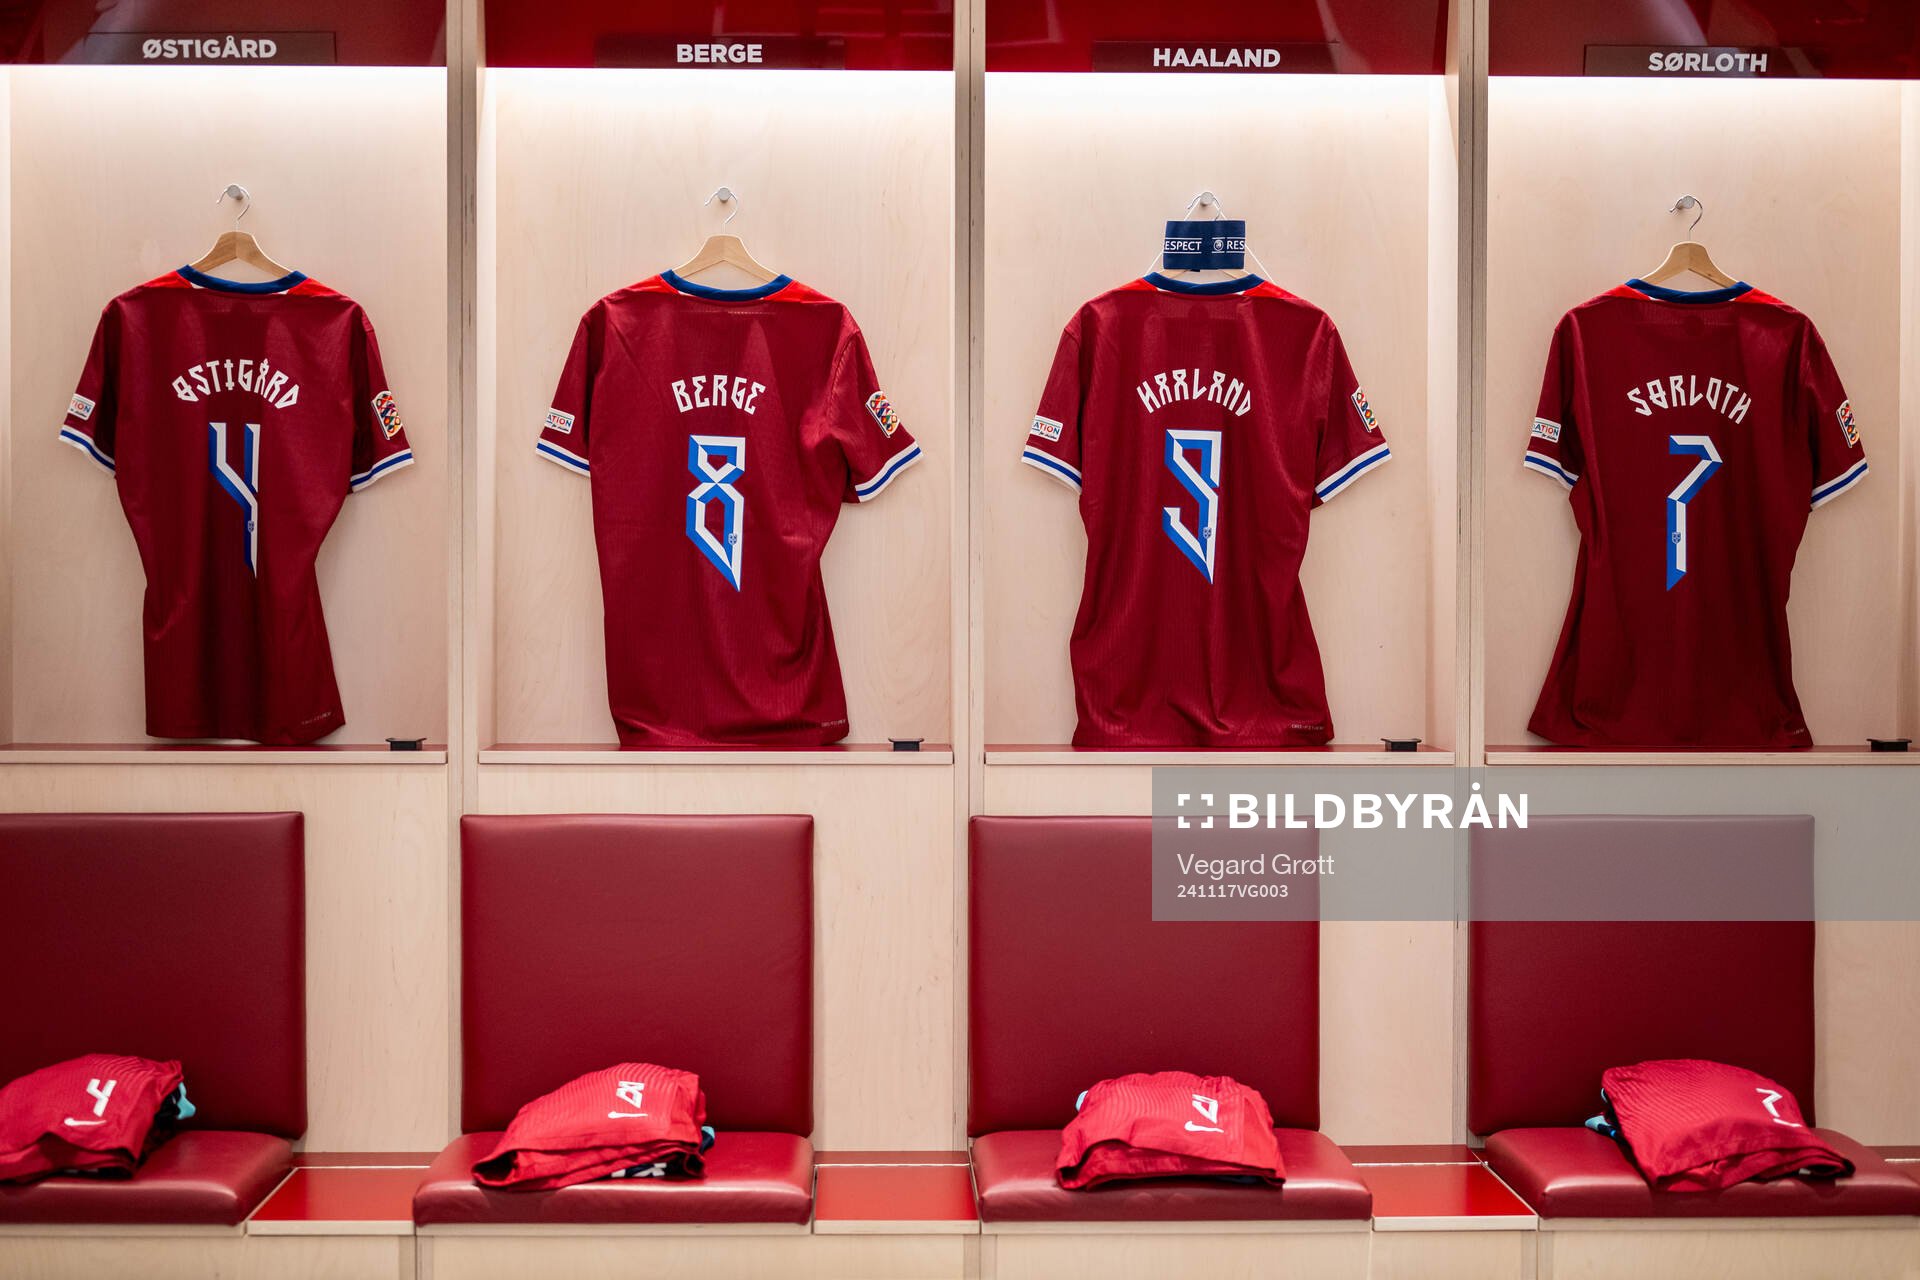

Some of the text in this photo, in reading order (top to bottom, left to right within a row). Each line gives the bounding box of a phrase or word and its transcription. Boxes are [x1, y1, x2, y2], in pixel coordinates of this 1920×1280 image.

[142, 35, 277, 59] ØSTIGÅRD
[676, 43, 763, 63] BERGE
[1153, 47, 1281, 68] HAALAND
[1648, 52, 1768, 73] SØRLOTH
[1164, 240, 1202, 251] ESPECT
[1226, 240, 1245, 250] RES
[171, 358, 300, 409] ØSTIGÅRD
[671, 374, 766, 415] BERGE
[1136, 368, 1251, 417] HAALAND
[1626, 374, 1752, 425] SØRLOTH
[208, 421, 261, 579] 4
[685, 434, 746, 593] 8
[1162, 428, 1222, 584] 9
[1665, 434, 1723, 592] 7
[86, 1078, 117, 1117] 4
